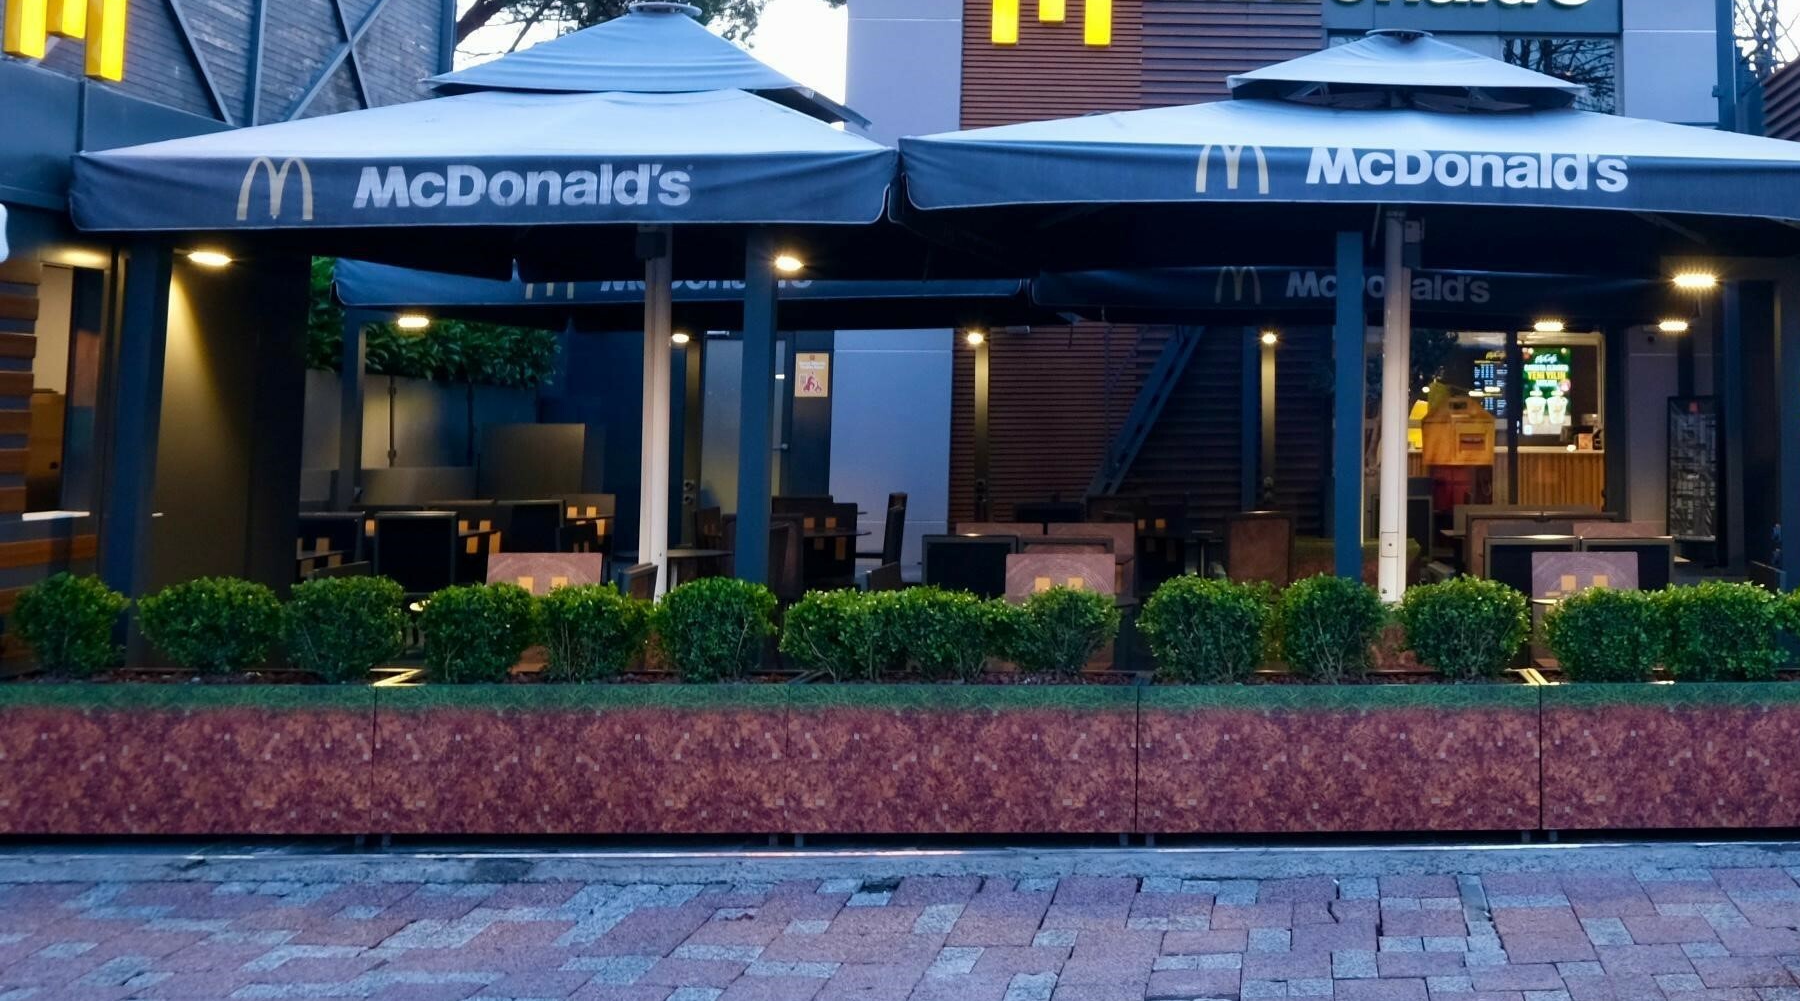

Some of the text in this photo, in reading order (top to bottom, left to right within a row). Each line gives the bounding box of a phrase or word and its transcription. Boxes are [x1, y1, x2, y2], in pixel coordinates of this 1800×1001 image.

[352, 163, 692, 209] McDonald's
[1306, 147, 1629, 193] McDonald's
[1286, 270, 1490, 303] Mcoald's
